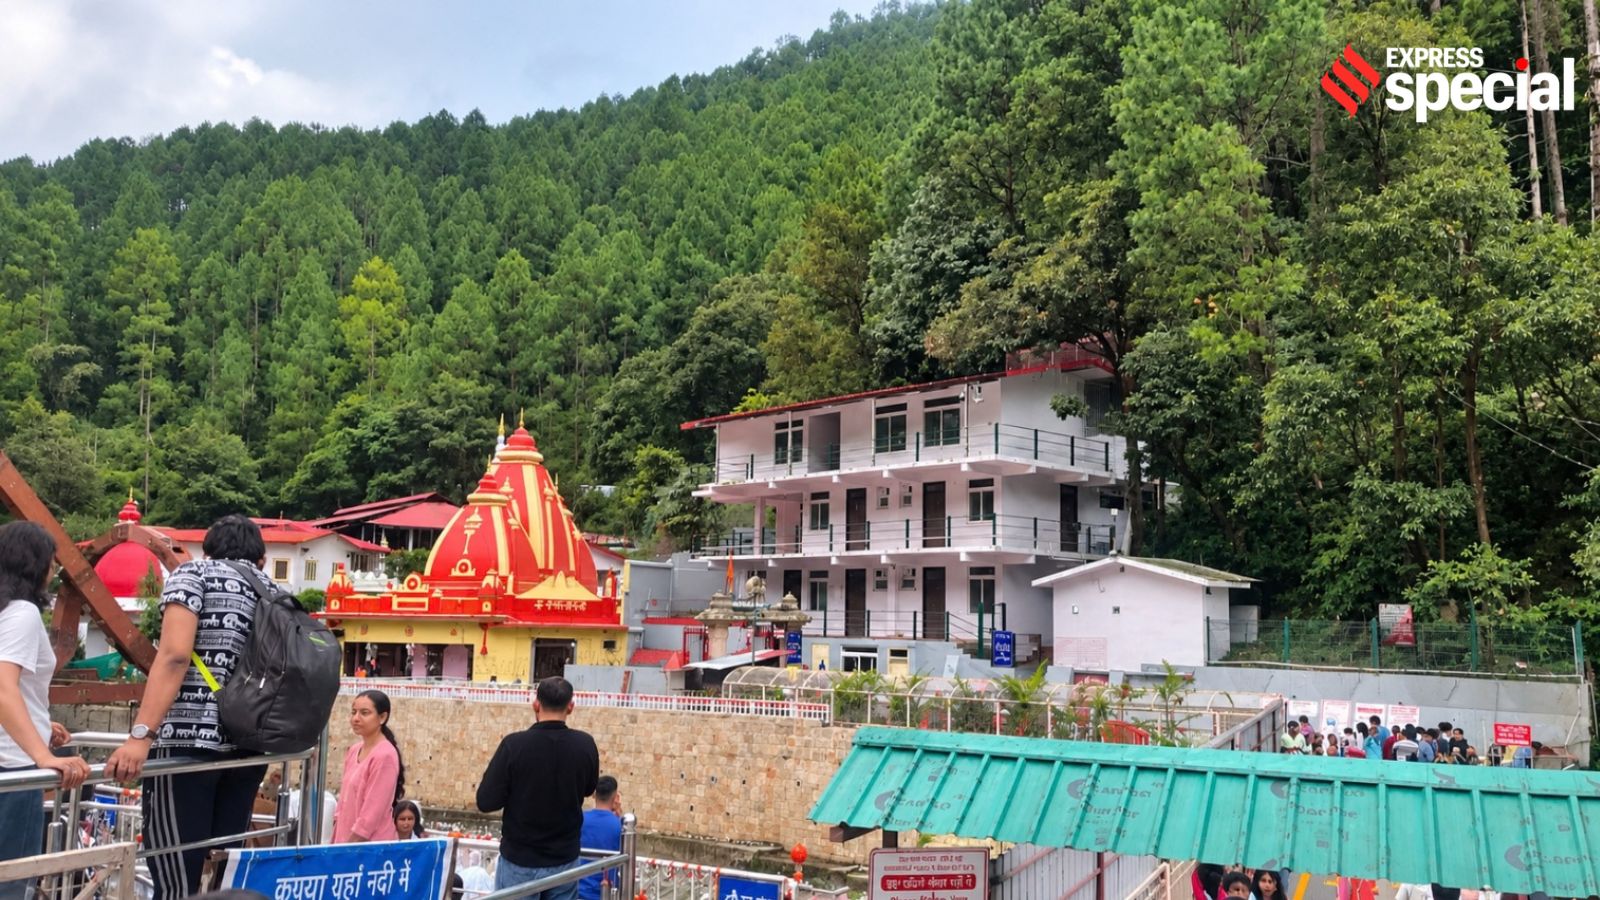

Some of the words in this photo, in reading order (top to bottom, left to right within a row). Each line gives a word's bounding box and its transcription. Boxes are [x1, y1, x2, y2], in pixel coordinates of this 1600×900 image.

[331, 863, 365, 900] यहां
[367, 859, 396, 896] नदी
[398, 858, 412, 893] में
